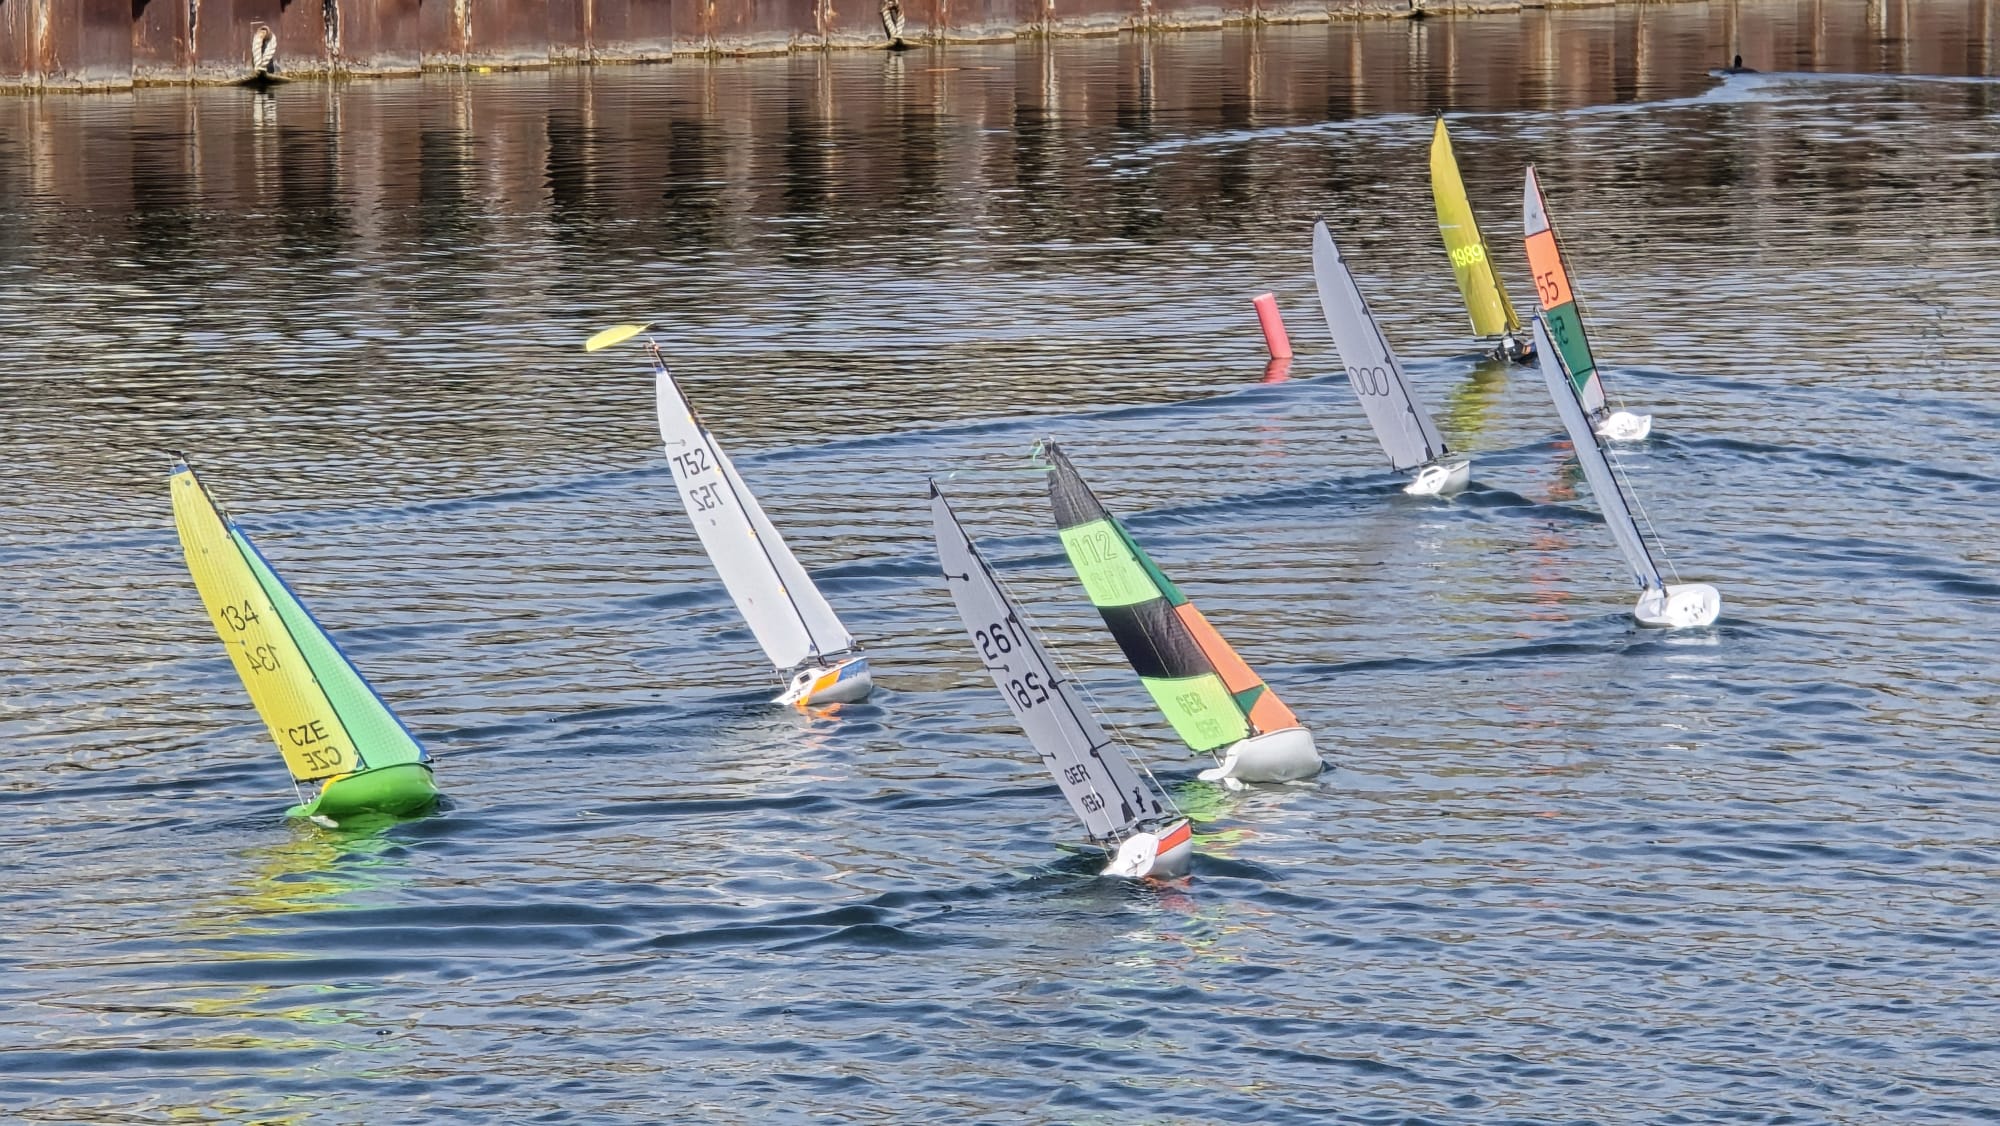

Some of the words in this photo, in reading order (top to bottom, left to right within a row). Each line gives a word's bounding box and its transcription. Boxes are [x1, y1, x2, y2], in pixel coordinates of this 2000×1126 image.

[1452, 244, 1484, 268] 1989
[1537, 271, 1559, 305] 55
[1348, 366, 1390, 397] 000
[673, 448, 711, 479] 752
[1069, 530, 1118, 566] 112
[220, 599, 260, 633] 134
[976, 617, 1022, 660] 261
[1175, 692, 1208, 715] GER
[289, 719, 330, 747] CZE
[1064, 763, 1090, 785] GER
